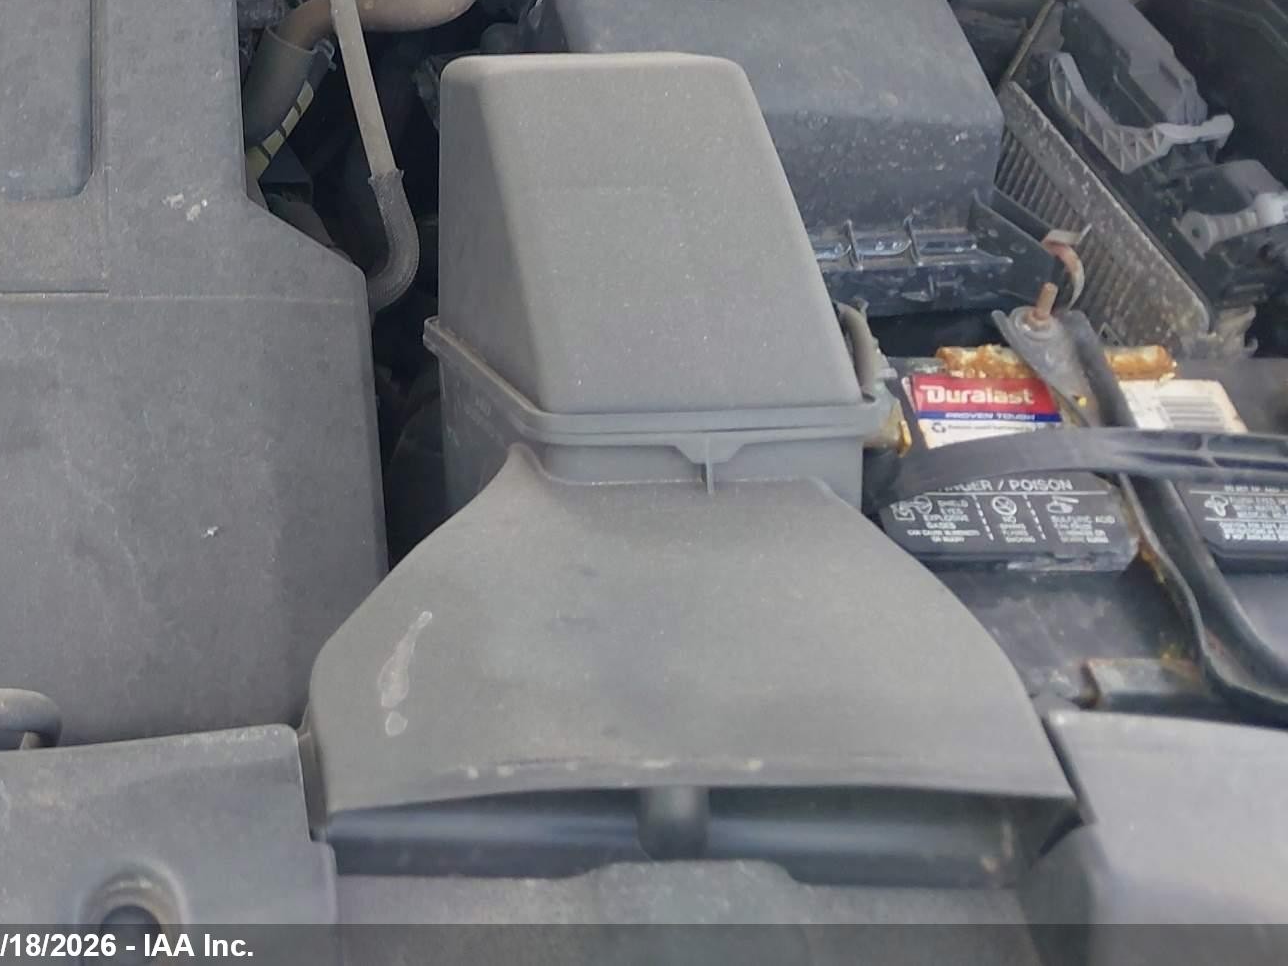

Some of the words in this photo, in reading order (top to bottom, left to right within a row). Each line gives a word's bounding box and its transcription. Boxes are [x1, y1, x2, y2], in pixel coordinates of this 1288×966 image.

[919, 384, 1035, 405] Duralast
[944, 411, 994, 420] PROVEN
[1009, 479, 1073, 492] POISON
